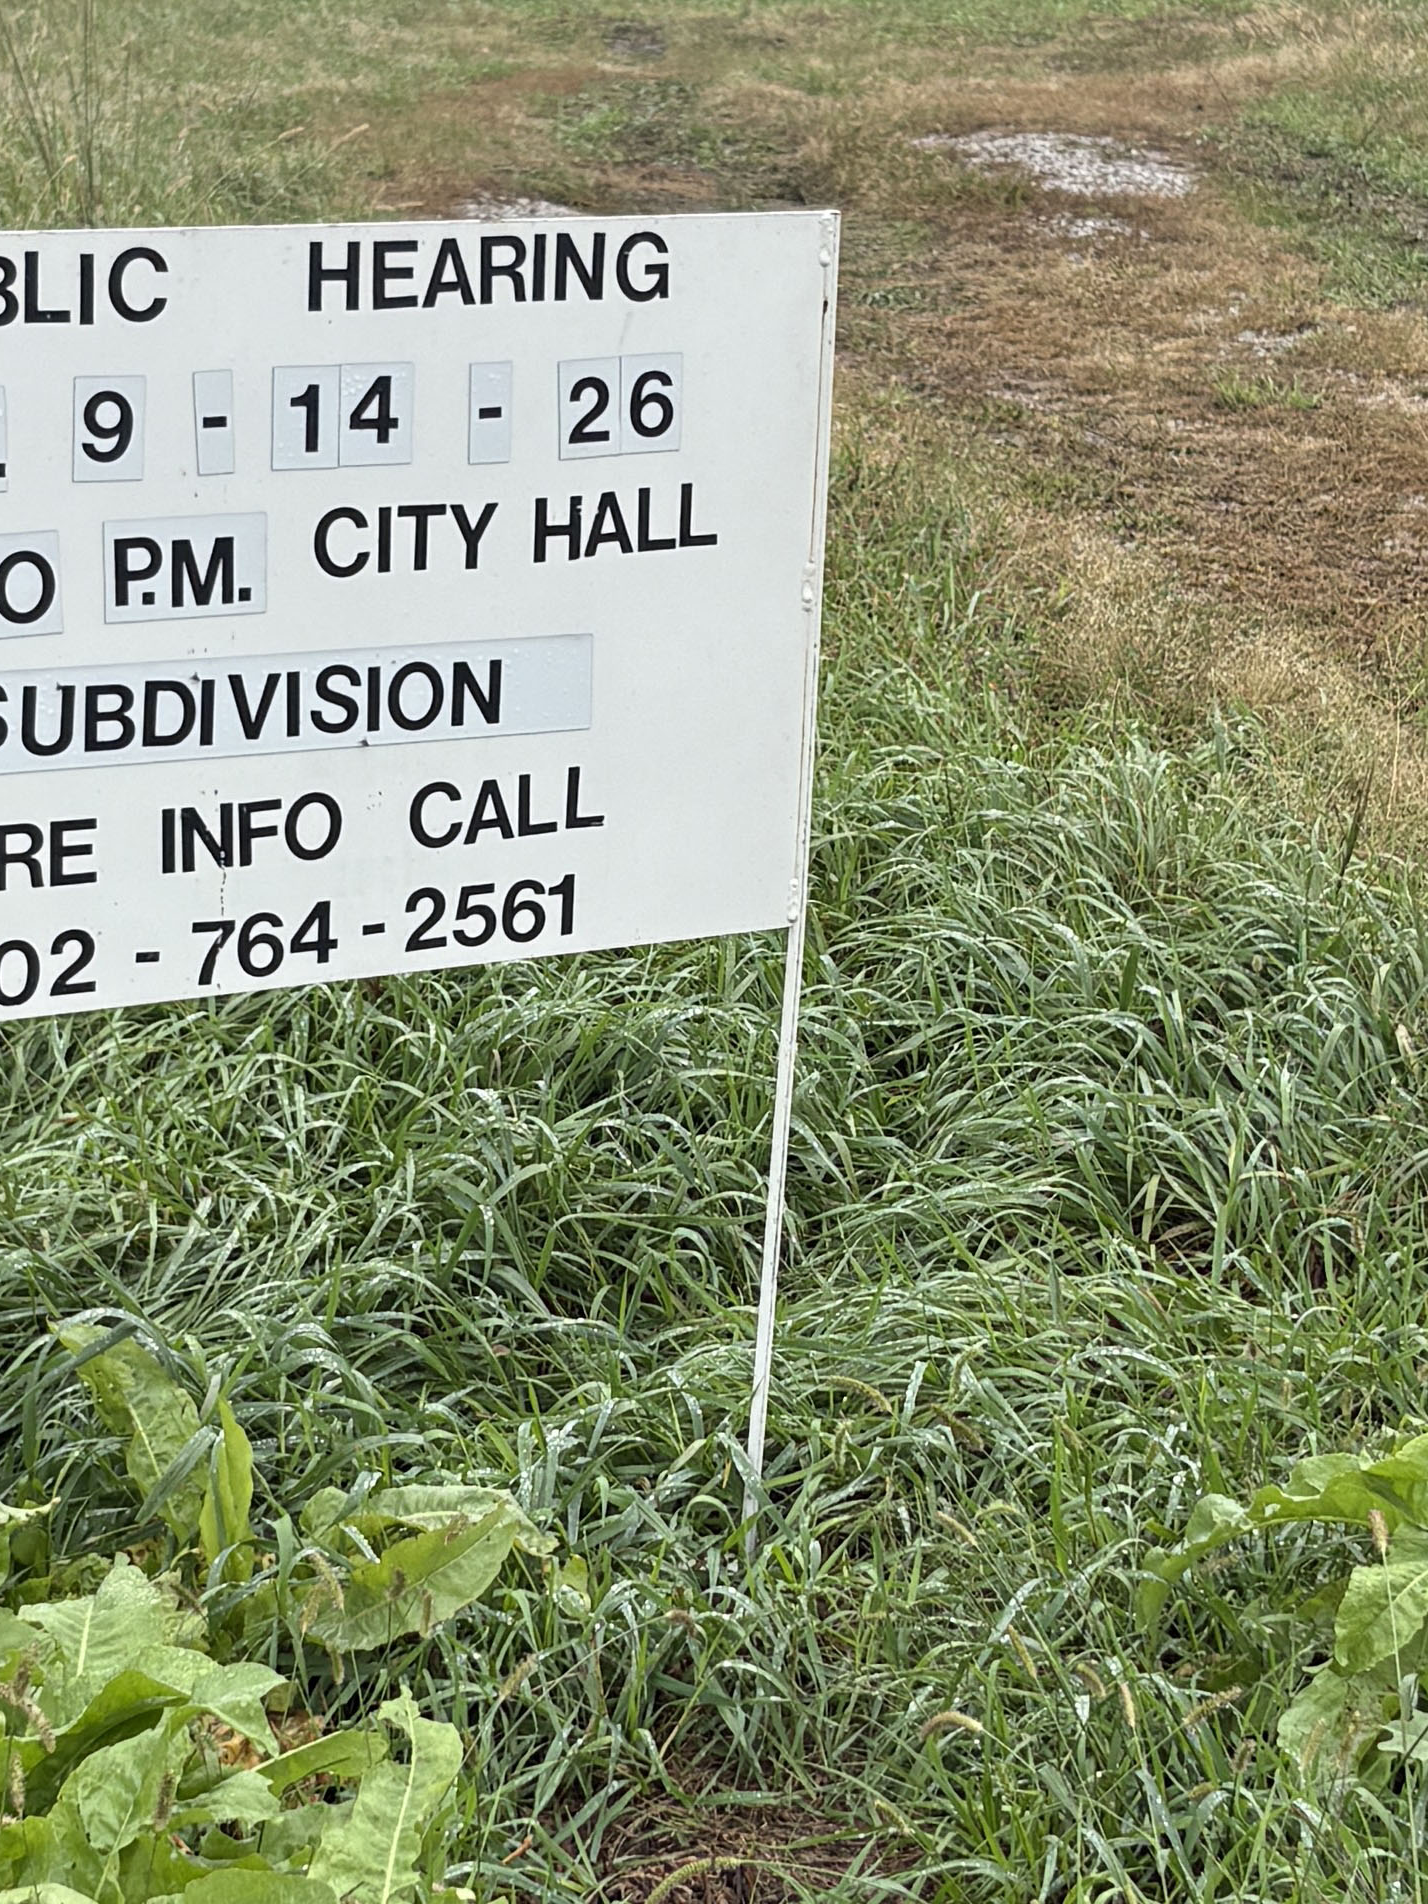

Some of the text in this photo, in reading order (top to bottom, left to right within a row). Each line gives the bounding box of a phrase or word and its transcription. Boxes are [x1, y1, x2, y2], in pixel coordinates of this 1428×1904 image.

[308, 232, 669, 312] HEARING
[81, 390, 134, 463] 9
[290, 375, 399, 453] 14
[568, 370, 674, 444] 26
[113, 536, 252, 608] P.M.
[313, 502, 499, 578] CITY
[533, 482, 718, 564] HALL
[161, 791, 343, 874] INFO
[409, 766, 605, 849] CALL
